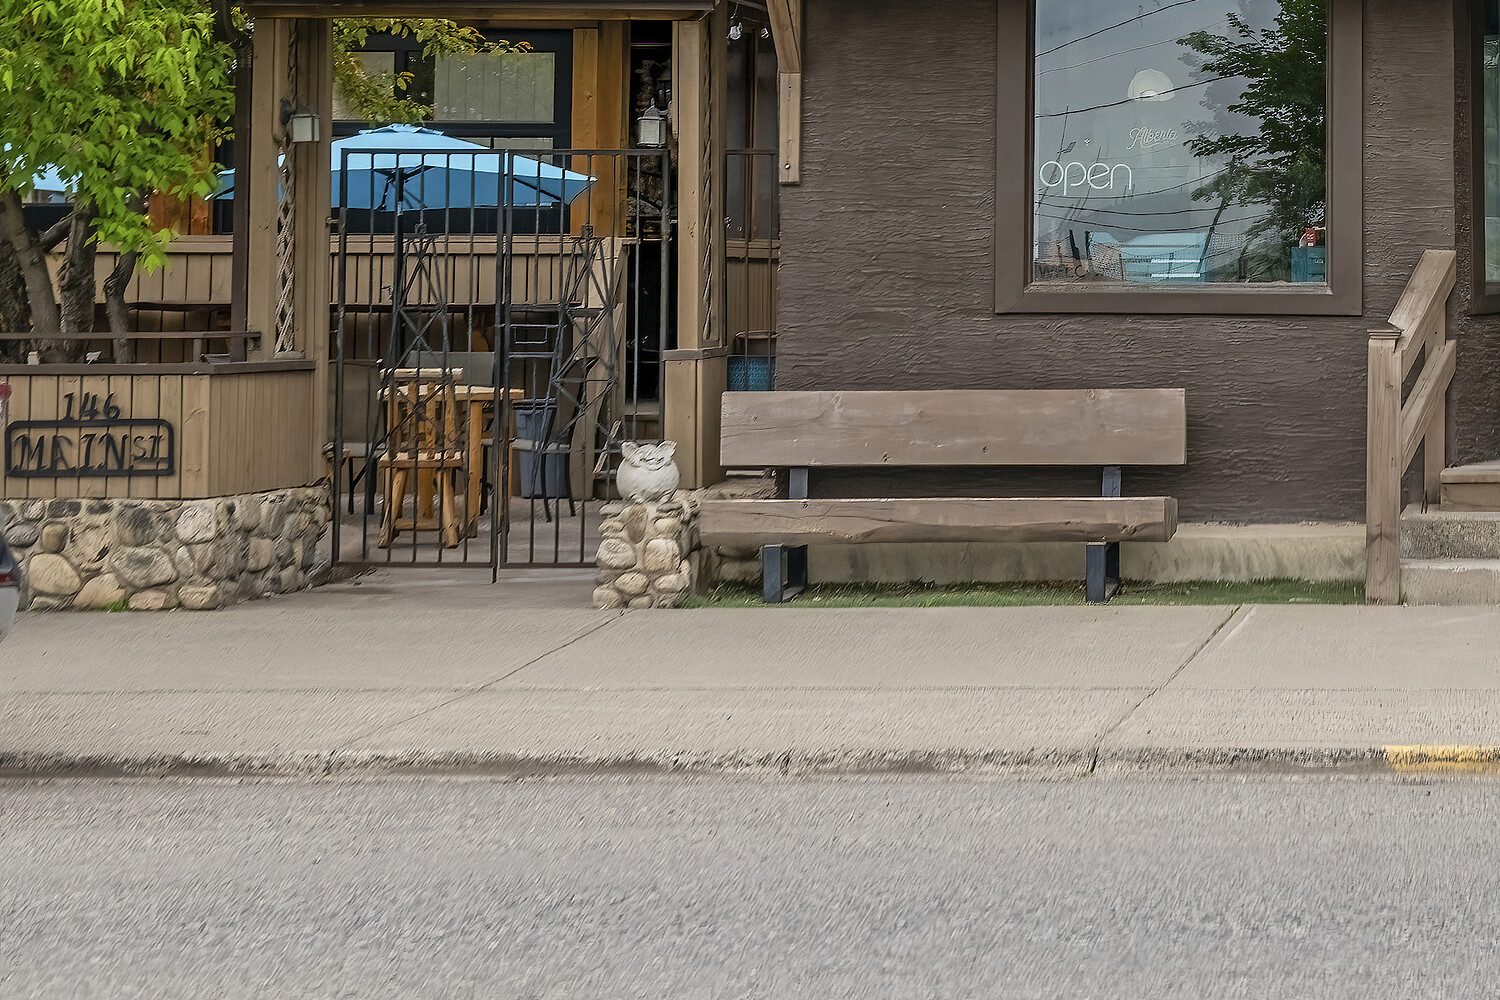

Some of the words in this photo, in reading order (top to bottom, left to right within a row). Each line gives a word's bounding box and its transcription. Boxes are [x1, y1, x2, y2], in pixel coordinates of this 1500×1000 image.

[1040, 161, 1132, 196] open
[63, 391, 121, 421] 146
[13, 432, 130, 473] MAIN
